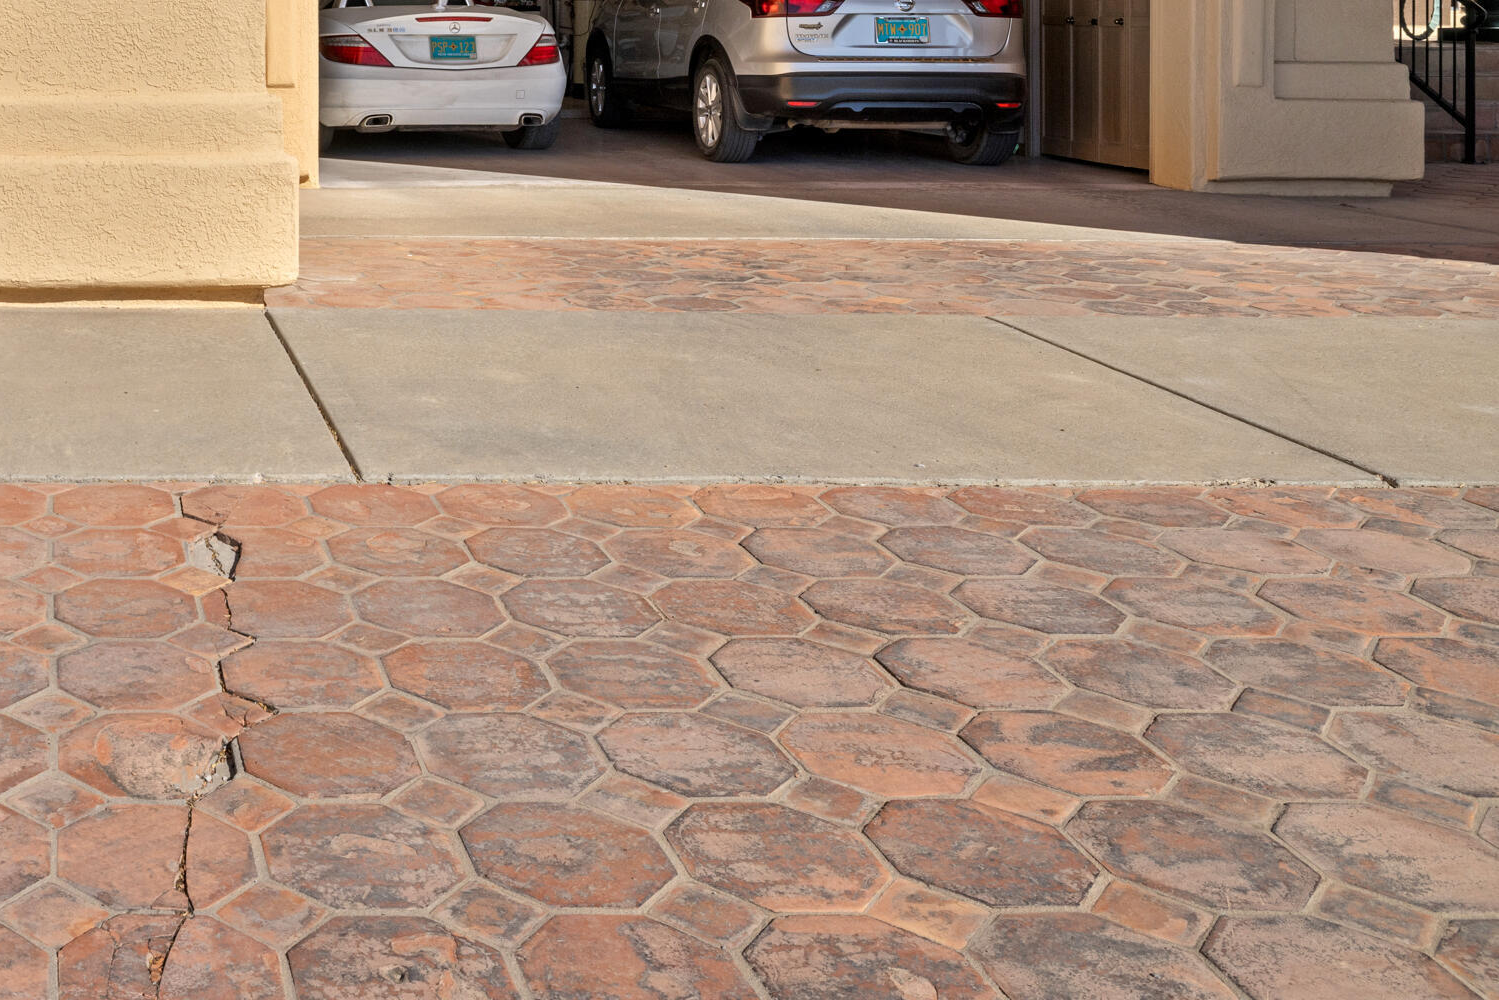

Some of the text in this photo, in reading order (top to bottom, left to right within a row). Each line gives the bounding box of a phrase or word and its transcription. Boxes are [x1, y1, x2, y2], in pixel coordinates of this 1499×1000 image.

[908, 23, 927, 36] 907
[431, 42, 476, 53] PSP 123
